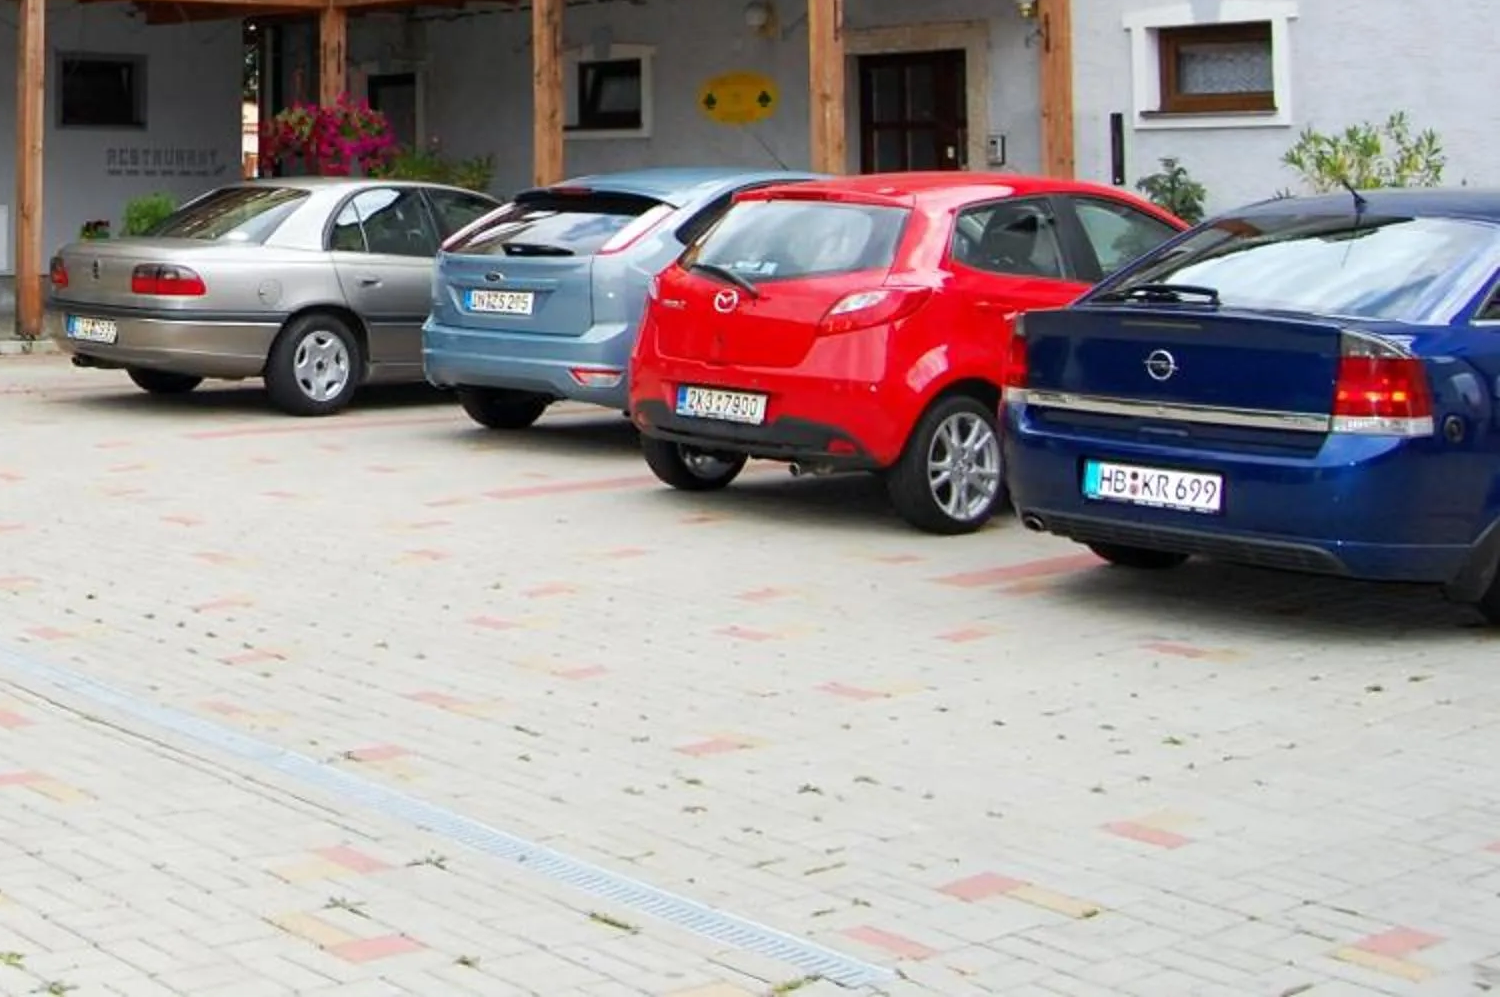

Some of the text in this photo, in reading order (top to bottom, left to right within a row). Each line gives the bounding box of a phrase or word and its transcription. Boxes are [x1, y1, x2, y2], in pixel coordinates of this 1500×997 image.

[1100, 466, 1217, 504] HB KR 699
